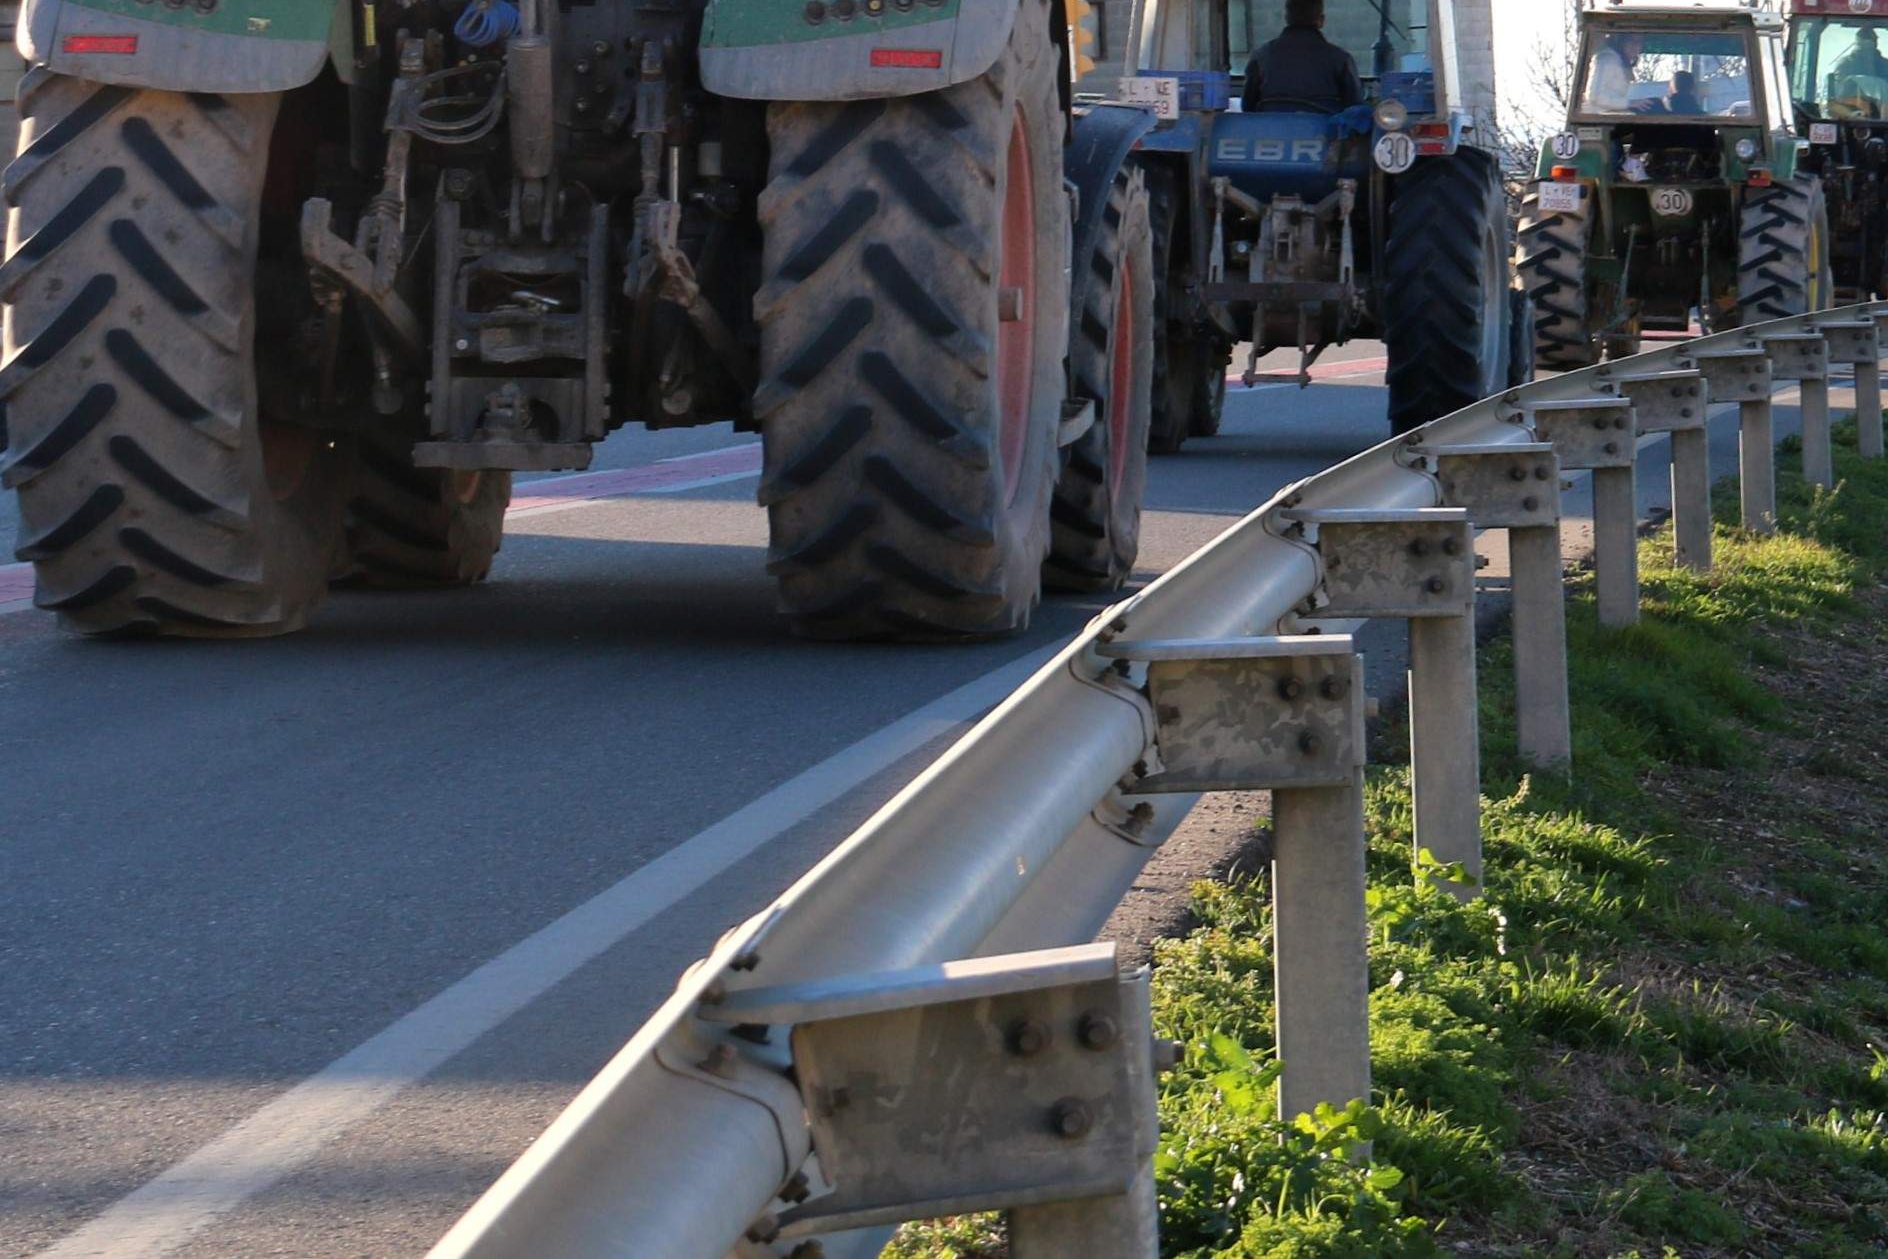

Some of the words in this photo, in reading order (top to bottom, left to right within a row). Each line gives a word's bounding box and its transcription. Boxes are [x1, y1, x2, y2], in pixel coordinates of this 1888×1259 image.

[1380, 136, 1410, 169] 30
[1556, 133, 1576, 157] 30
[1660, 192, 1683, 211] 30
